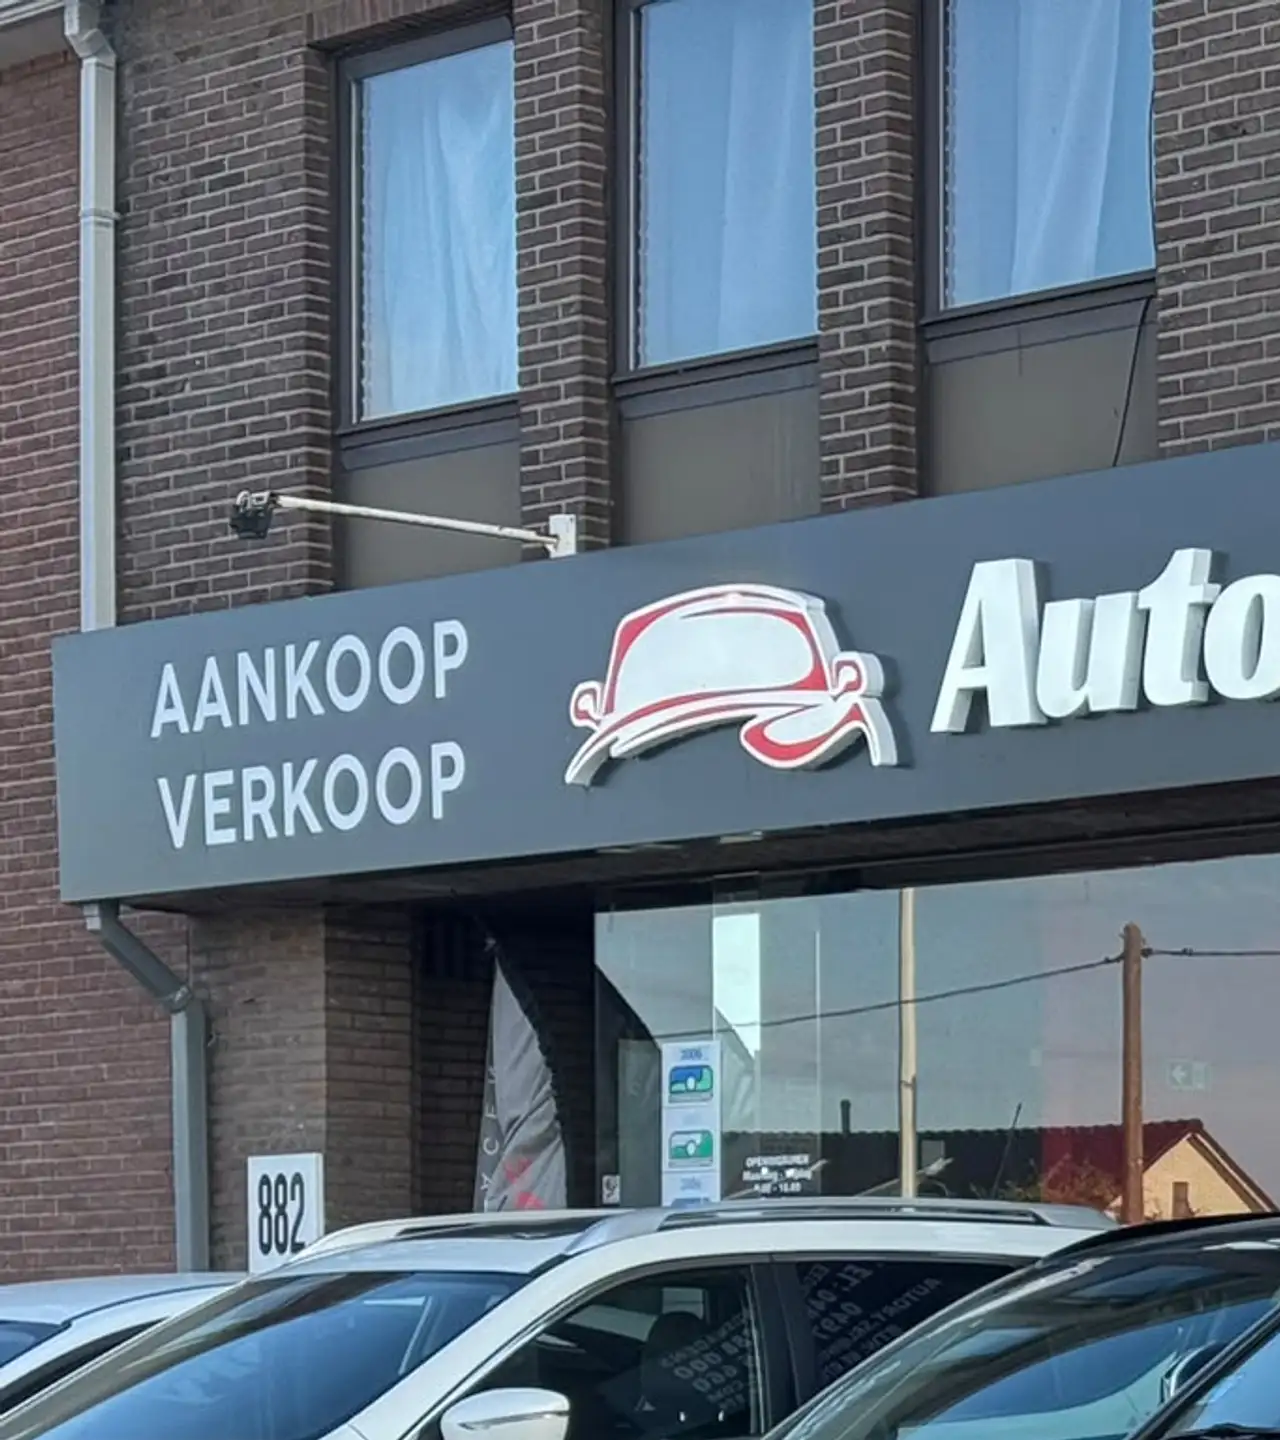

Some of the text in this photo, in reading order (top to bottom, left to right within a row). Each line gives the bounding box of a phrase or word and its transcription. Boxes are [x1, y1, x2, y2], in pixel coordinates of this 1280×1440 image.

[150, 619, 469, 739] AANKOOP
[156, 741, 466, 849] VERKOOP
[257, 1171, 306, 1256] 882
